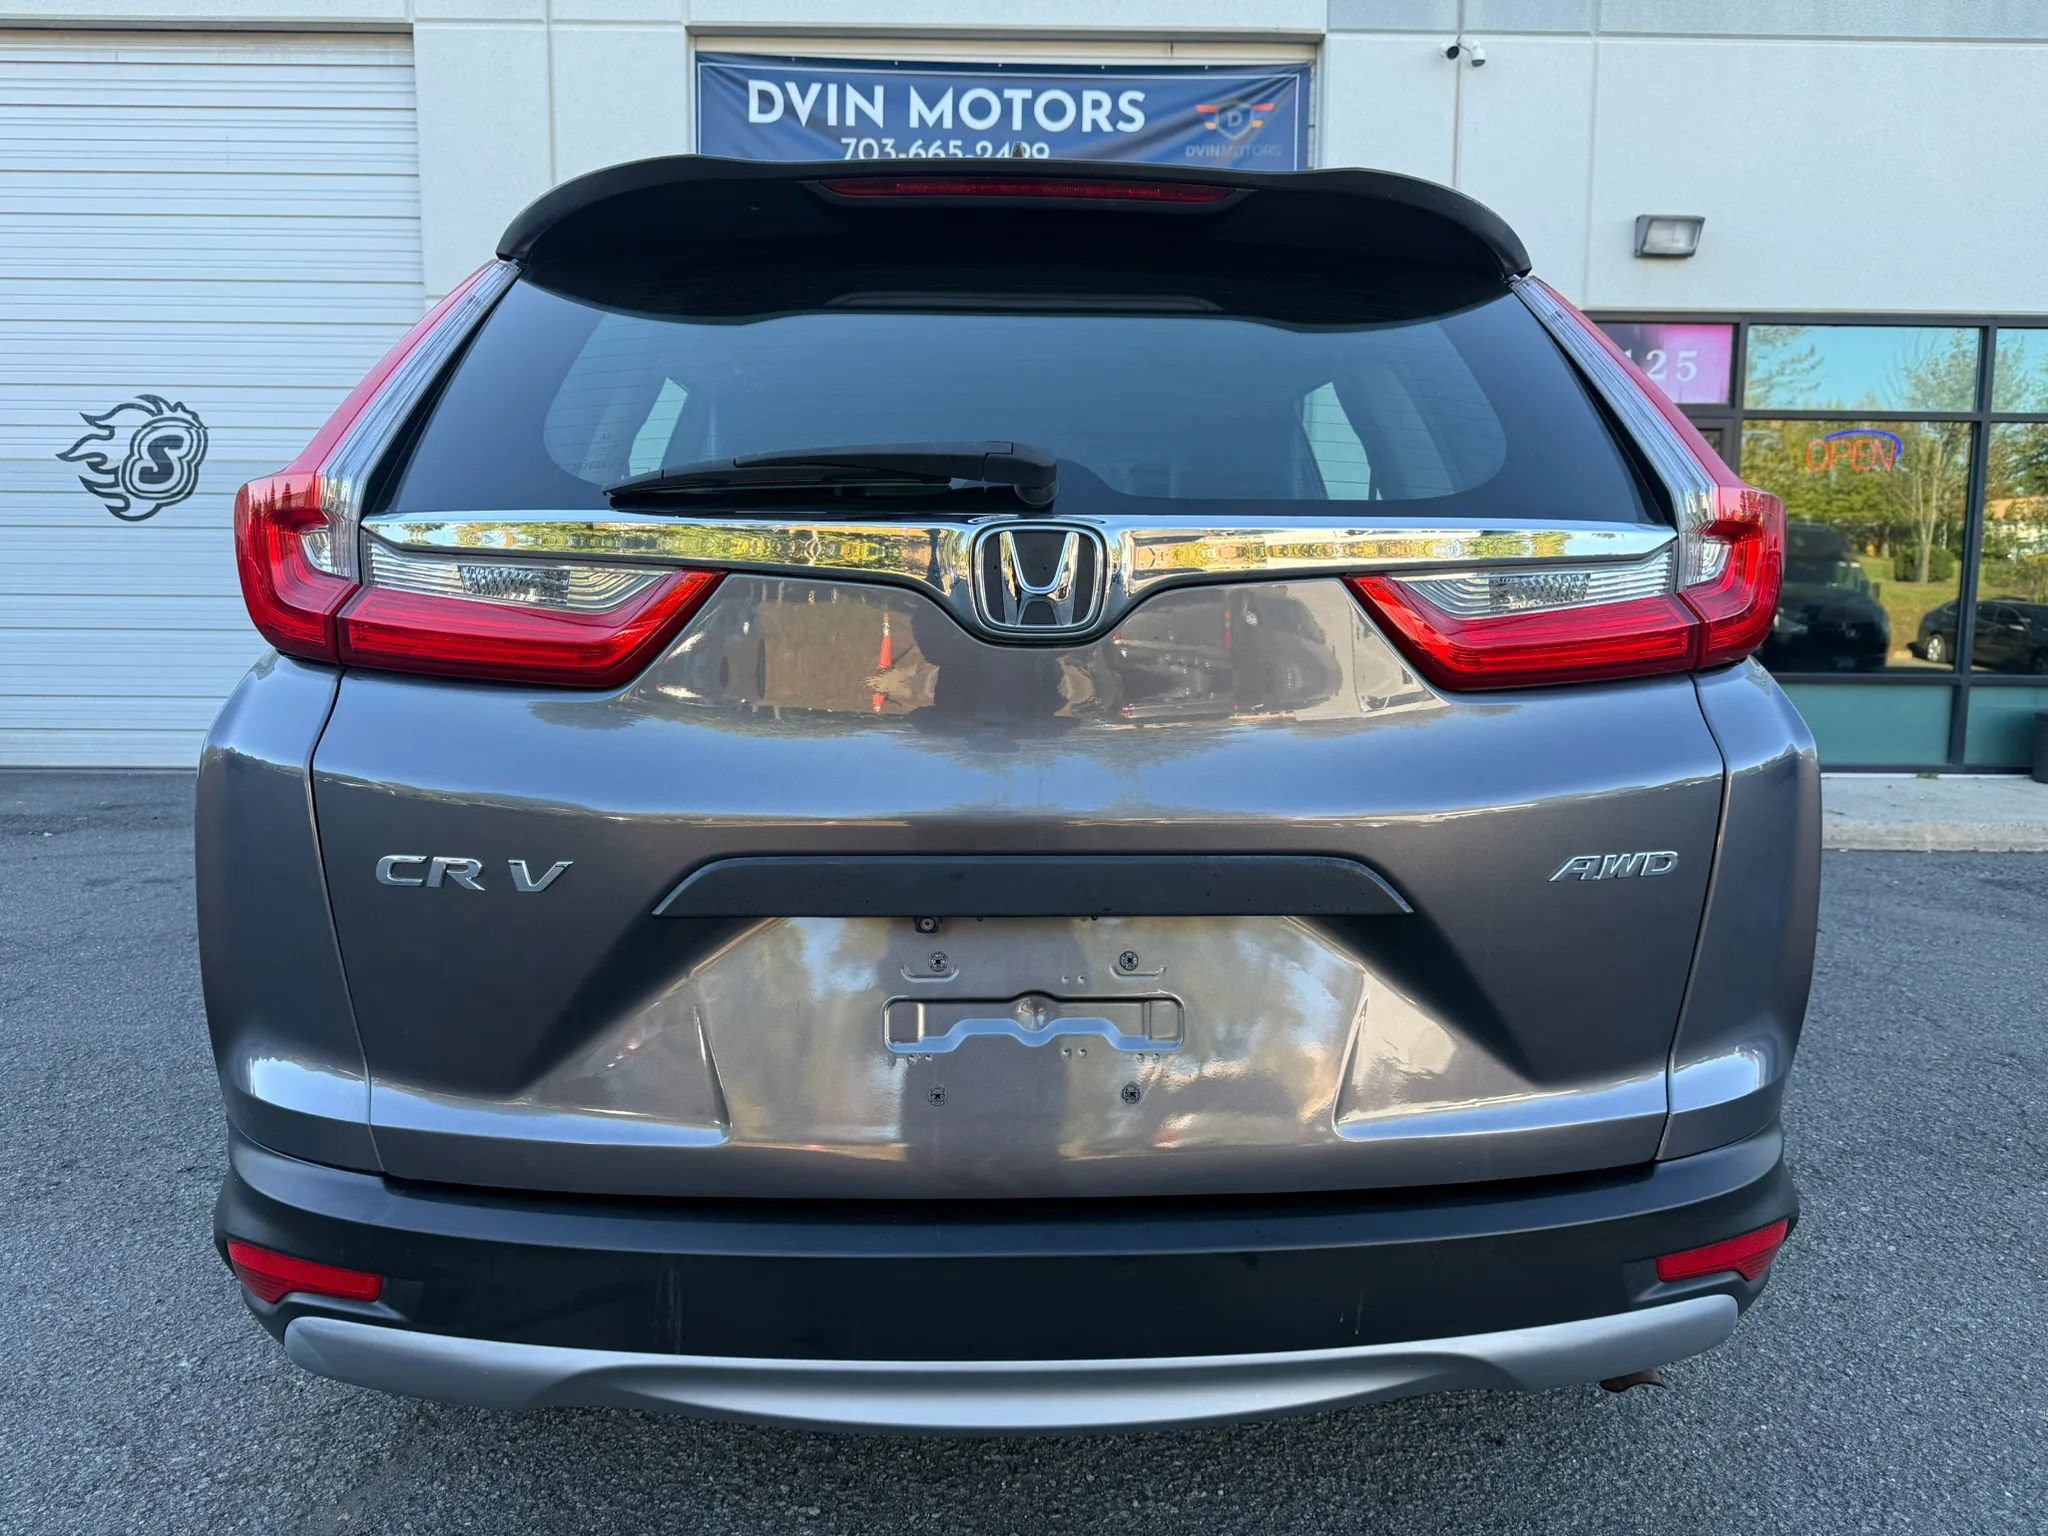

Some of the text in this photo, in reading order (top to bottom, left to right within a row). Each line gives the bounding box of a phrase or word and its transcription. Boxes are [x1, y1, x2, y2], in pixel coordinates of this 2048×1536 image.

[747, 79, 1146, 133] DVIN MOTORS
[1625, 348, 1698, 381] 25
[1805, 438, 1897, 472] OPEN
[1547, 850, 1680, 882] AWD
